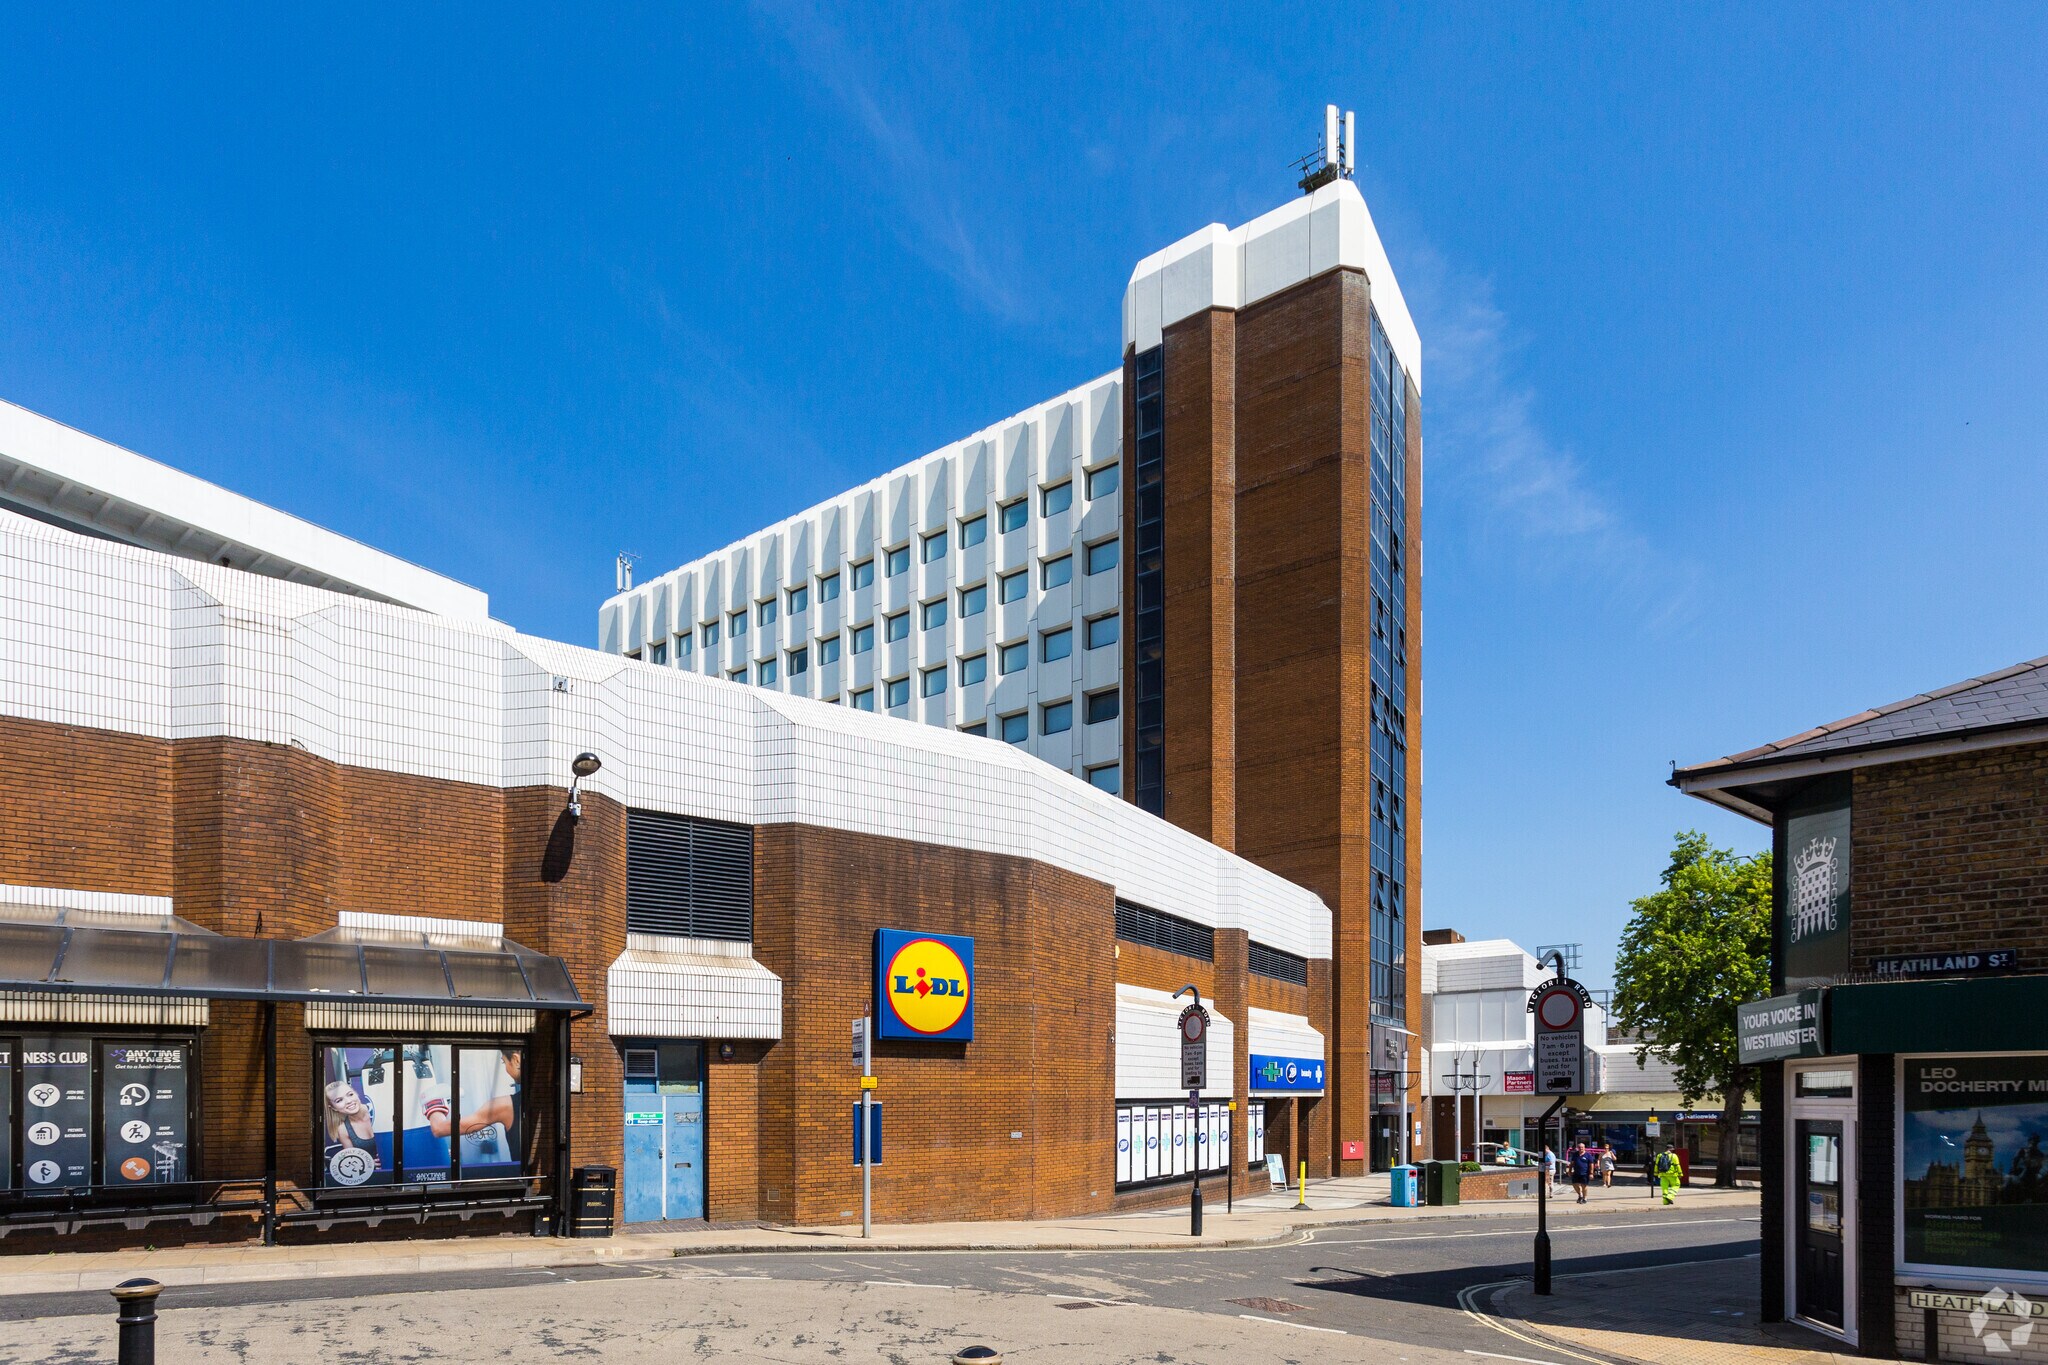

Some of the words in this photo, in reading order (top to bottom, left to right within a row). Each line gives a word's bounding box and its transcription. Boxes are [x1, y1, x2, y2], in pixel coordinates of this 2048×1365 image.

[1877, 955, 1980, 973] HEATHLAND
[1574, 984, 1591, 1008] ROAD
[864, 1004, 869, 1012] A
[1743, 1012, 1769, 1029] YOUR
[1771, 1005, 1802, 1025] VOICE
[1804, 1003, 1816, 1019] IN
[1743, 1026, 1817, 1051] WESTMINSTER
[23, 1052, 56, 1063] NESS
[59, 1052, 88, 1063] CLUB
[126, 1049, 180, 1057] ANYTIME
[1921, 1067, 1956, 1079] LEO
[1921, 1080, 2022, 1092] DOCHERTY
[1916, 1294, 2044, 1316] HEATHLAND
